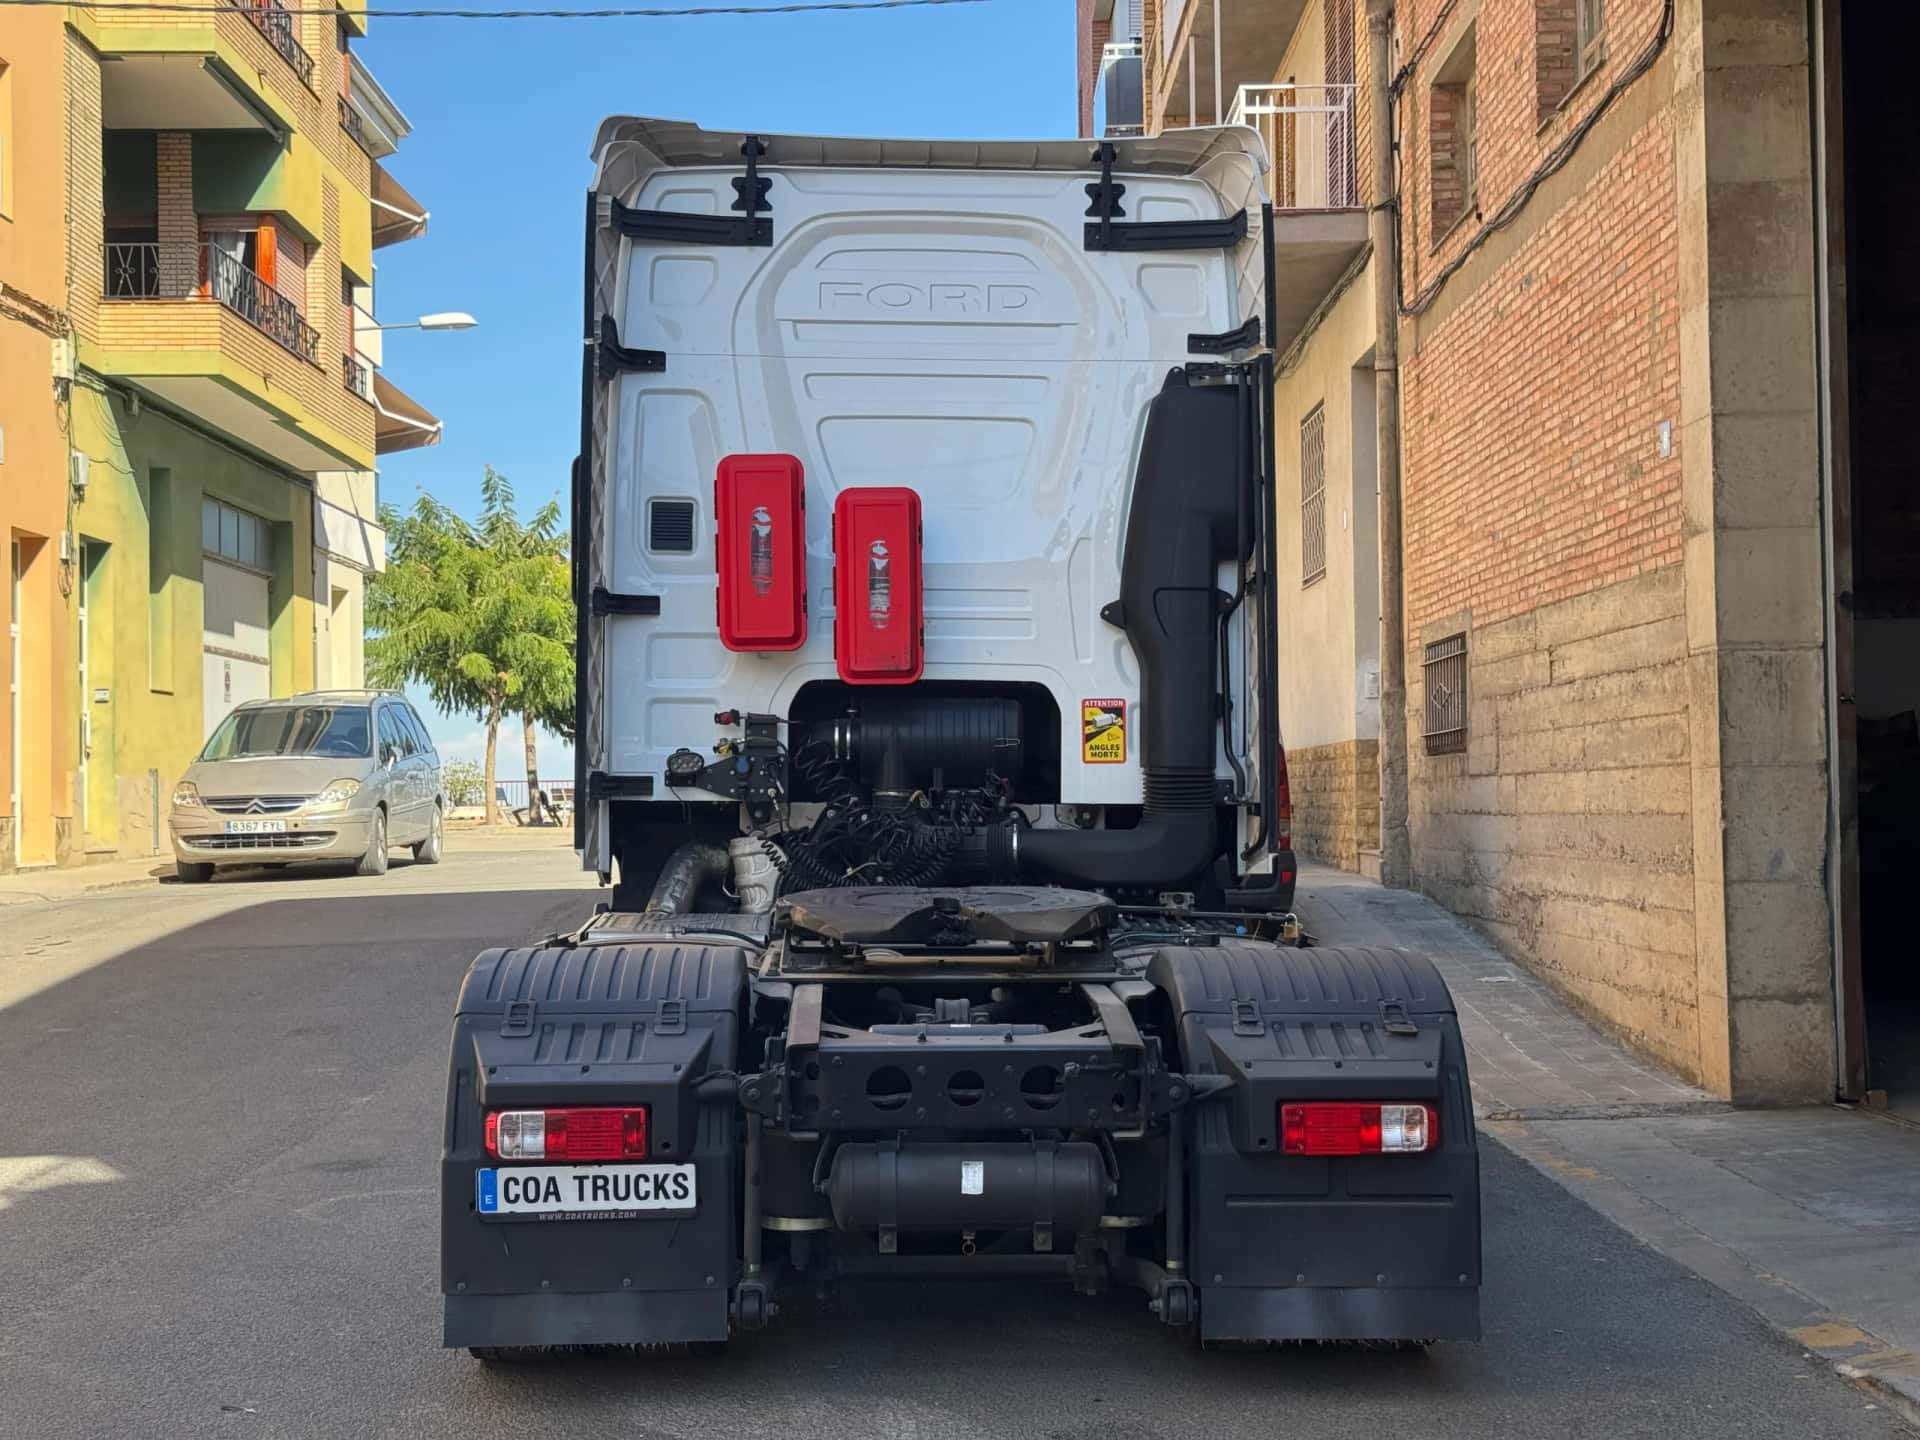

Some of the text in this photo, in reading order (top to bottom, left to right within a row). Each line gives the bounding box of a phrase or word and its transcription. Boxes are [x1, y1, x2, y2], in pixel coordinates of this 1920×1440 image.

[818, 281, 1041, 313] FORD
[1088, 743, 1121, 751] ANGLES
[503, 1172, 690, 1205] COA TRUCKS
[484, 1194, 493, 1205] E
